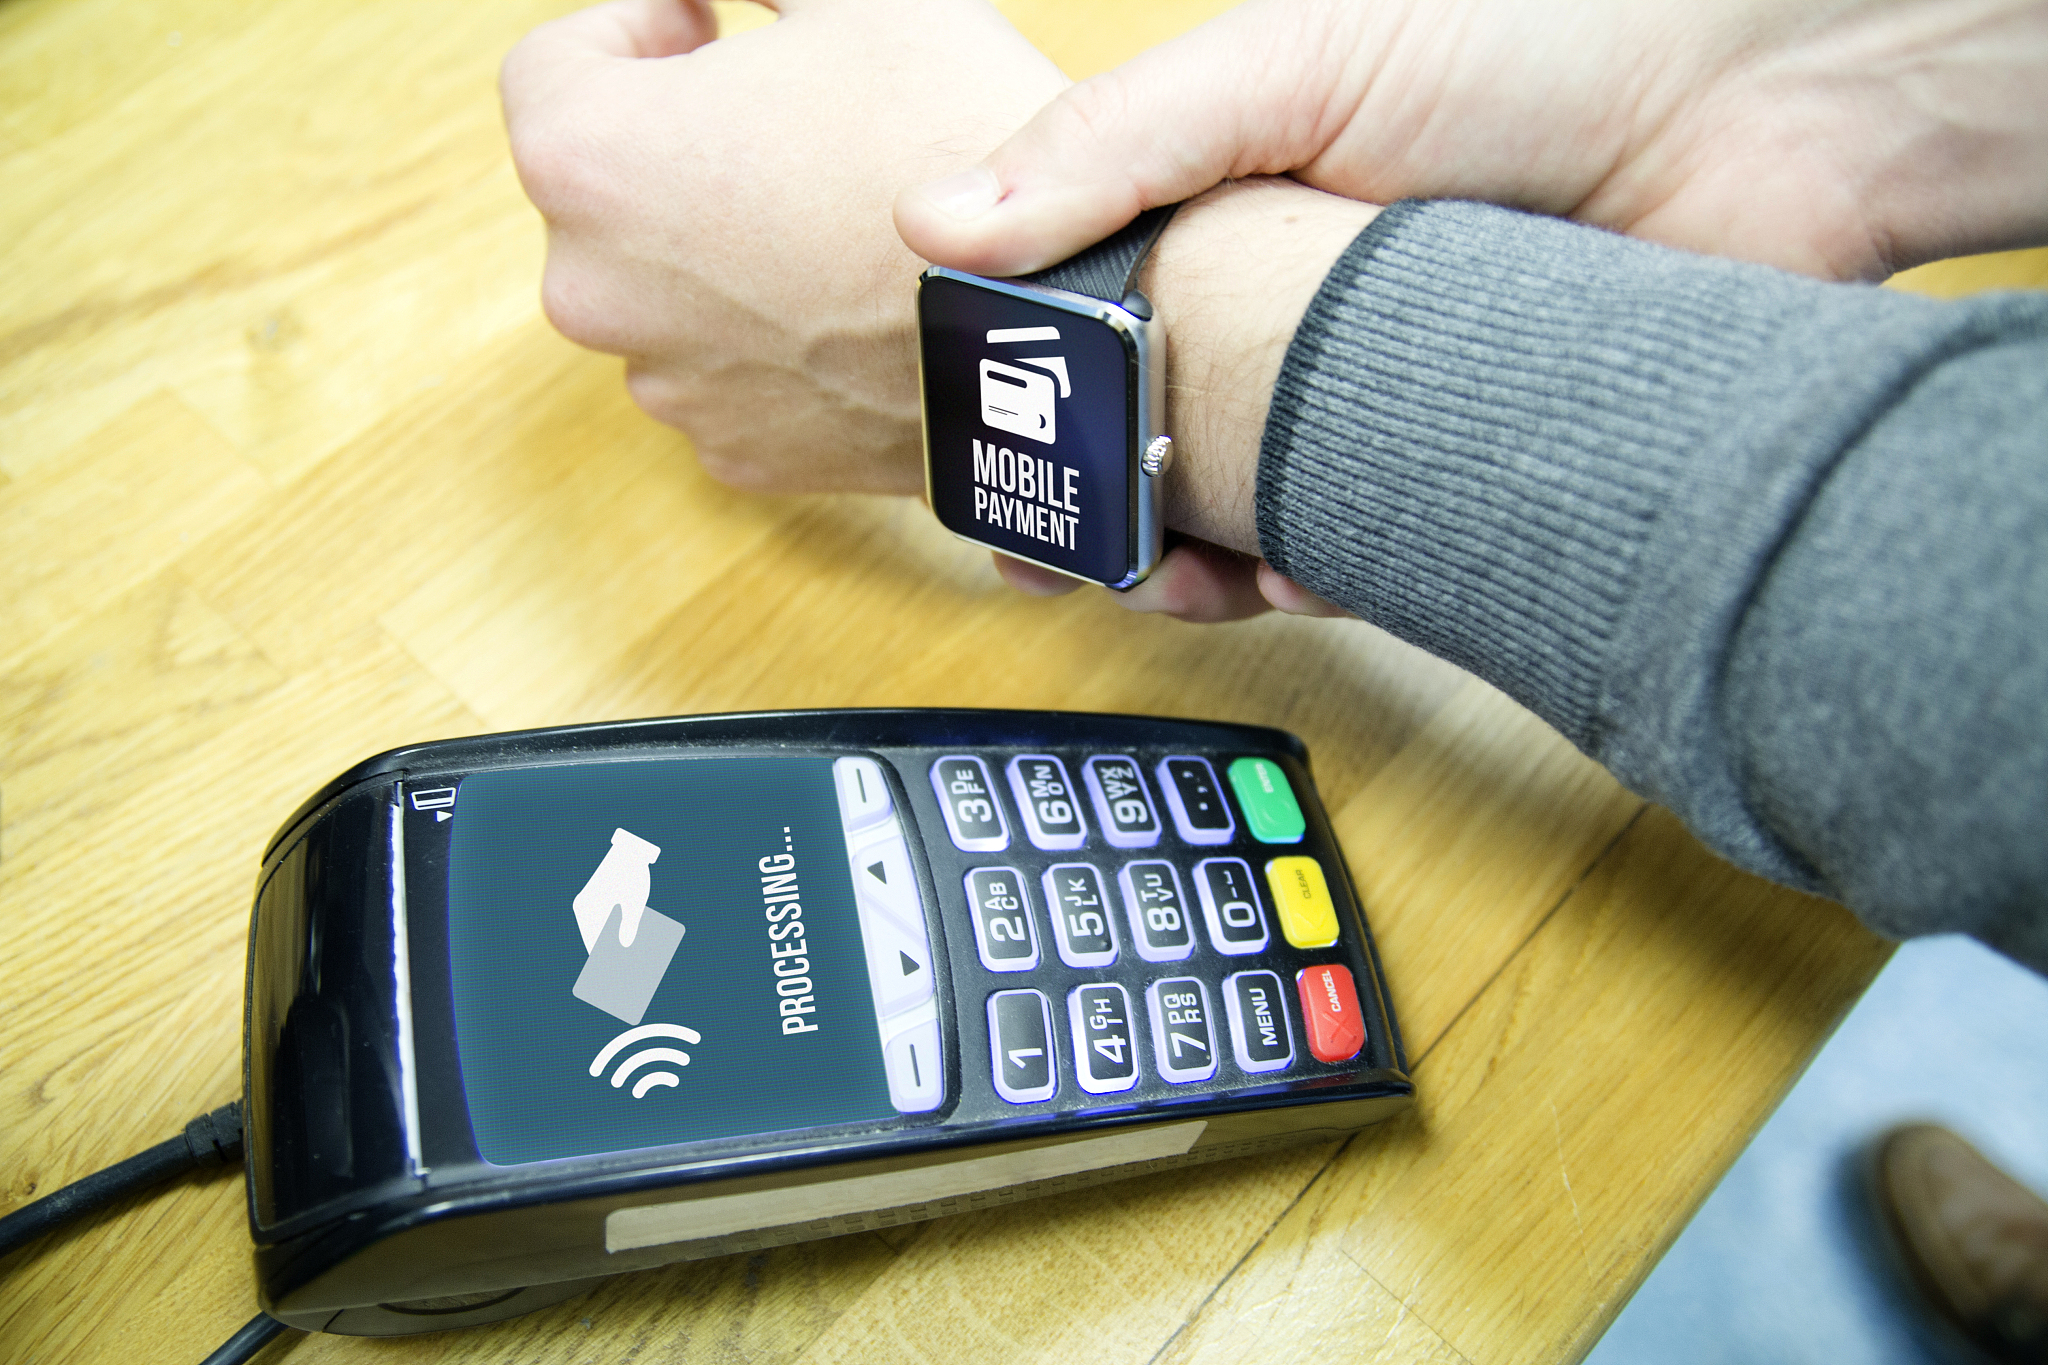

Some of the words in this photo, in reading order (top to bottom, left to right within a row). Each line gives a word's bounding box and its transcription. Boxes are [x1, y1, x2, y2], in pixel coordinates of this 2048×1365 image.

[972, 438, 1080, 514] MOBILE
[974, 486, 1079, 551] PAYMENT
[958, 798, 992, 823] 3
[1039, 800, 1073, 824] 6
[1115, 799, 1148, 823] 9
[1295, 869, 1312, 899] CLEAR
[758, 826, 819, 1035] PROCESSING...
[990, 916, 1025, 942] 2
[1066, 912, 1104, 937] 5
[1147, 906, 1181, 931] 8
[1321, 970, 1341, 1012] CANCEL
[1248, 988, 1279, 1046] MENU
[1008, 1047, 1043, 1069] 1
[1095, 1034, 1127, 1064] 4
[1170, 1032, 1207, 1058] 7
